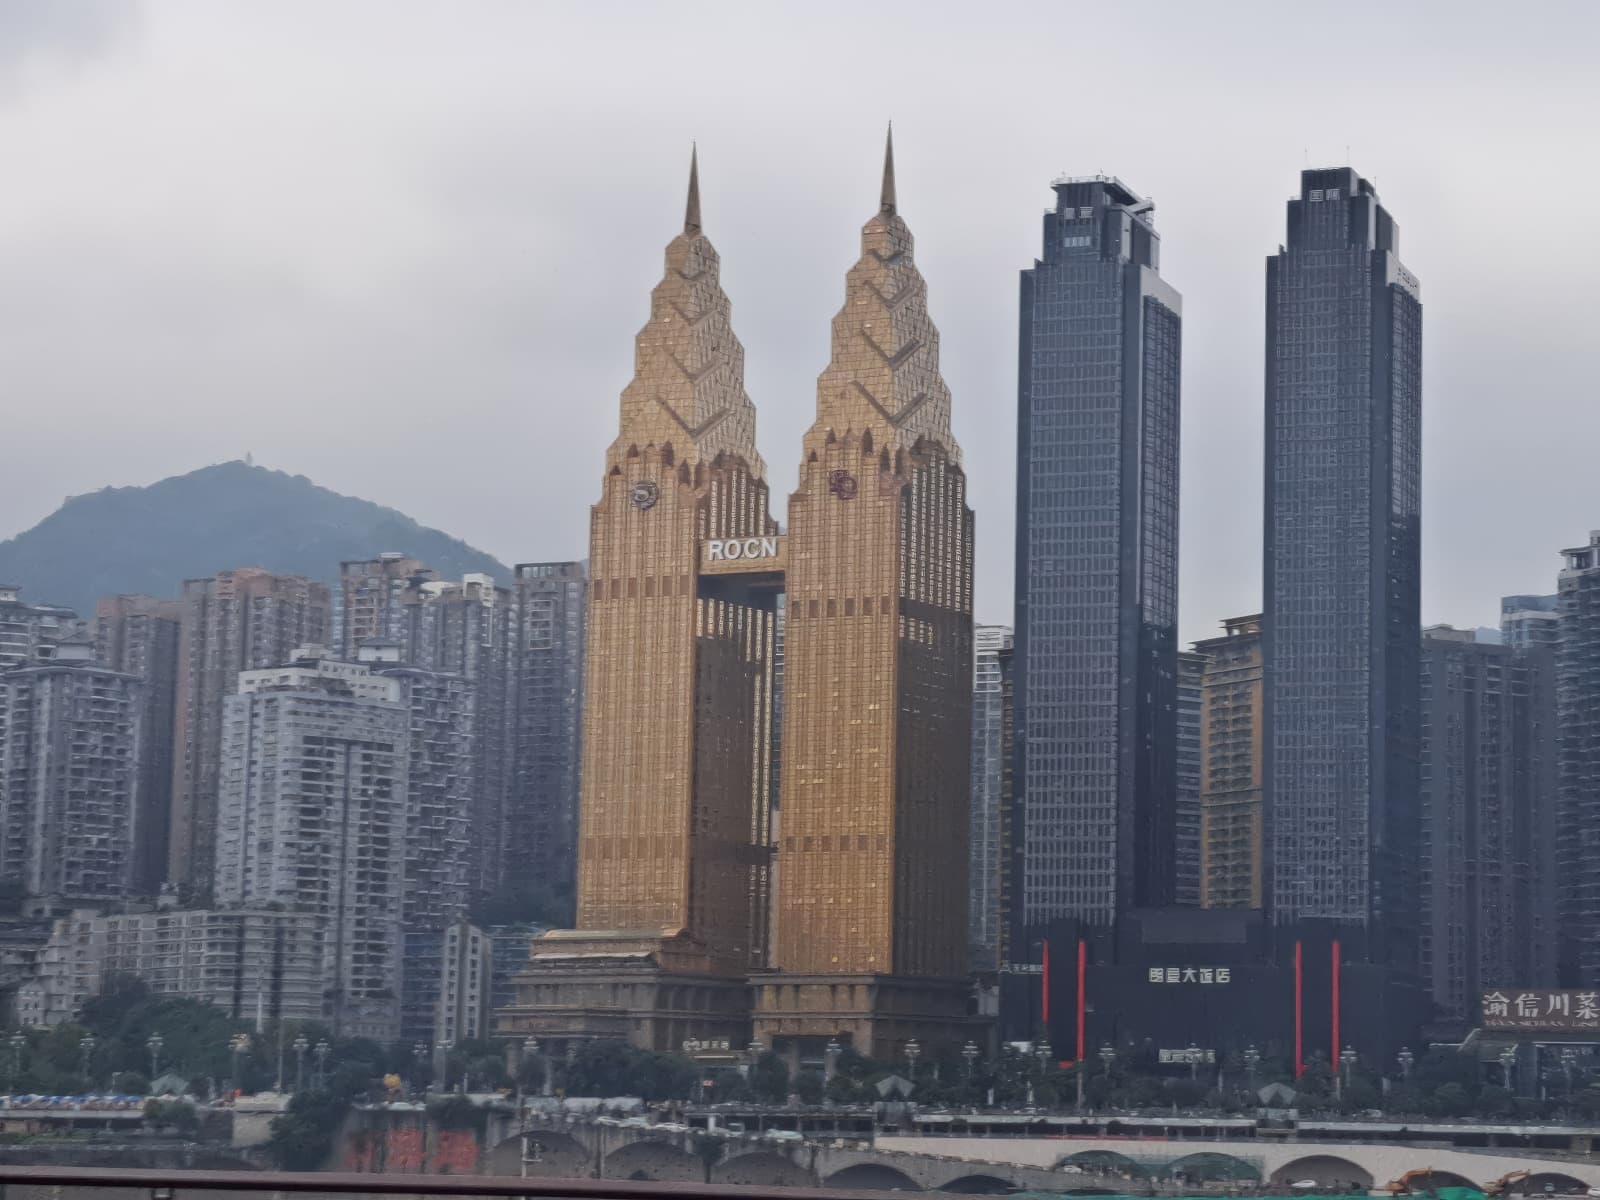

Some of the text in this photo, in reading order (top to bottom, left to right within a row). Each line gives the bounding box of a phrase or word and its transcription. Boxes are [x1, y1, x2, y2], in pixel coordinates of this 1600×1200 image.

[708, 538, 777, 560] ROCN
[1481, 991, 1600, 1019] 渝信川菜
